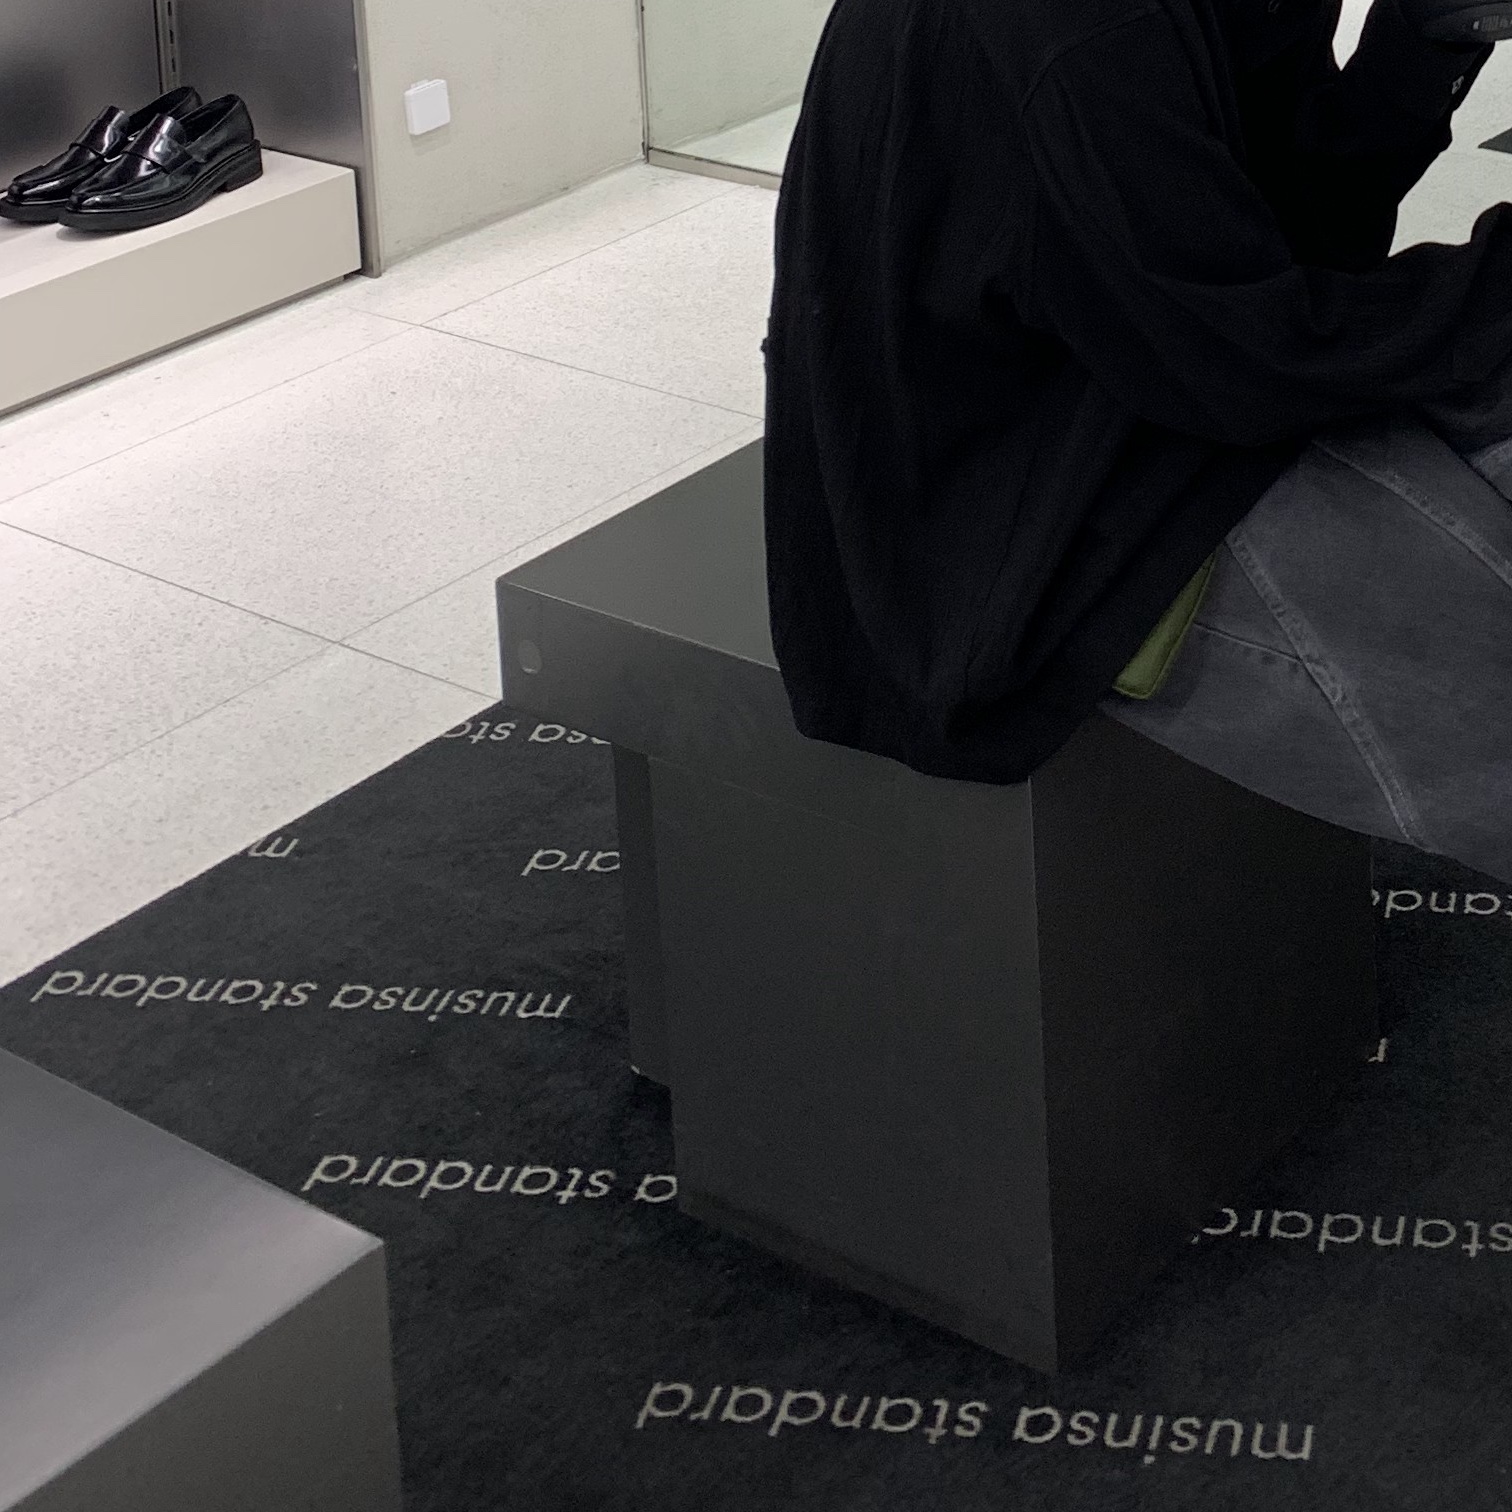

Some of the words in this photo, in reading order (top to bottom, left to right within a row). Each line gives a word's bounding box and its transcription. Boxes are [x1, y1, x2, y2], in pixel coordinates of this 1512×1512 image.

[31, 969, 318, 1014] standard
[332, 983, 573, 1024] musinsa
[301, 1153, 612, 1208] standard
[634, 1379, 989, 1445] standard
[1011, 1406, 1316, 1467] musinsa
